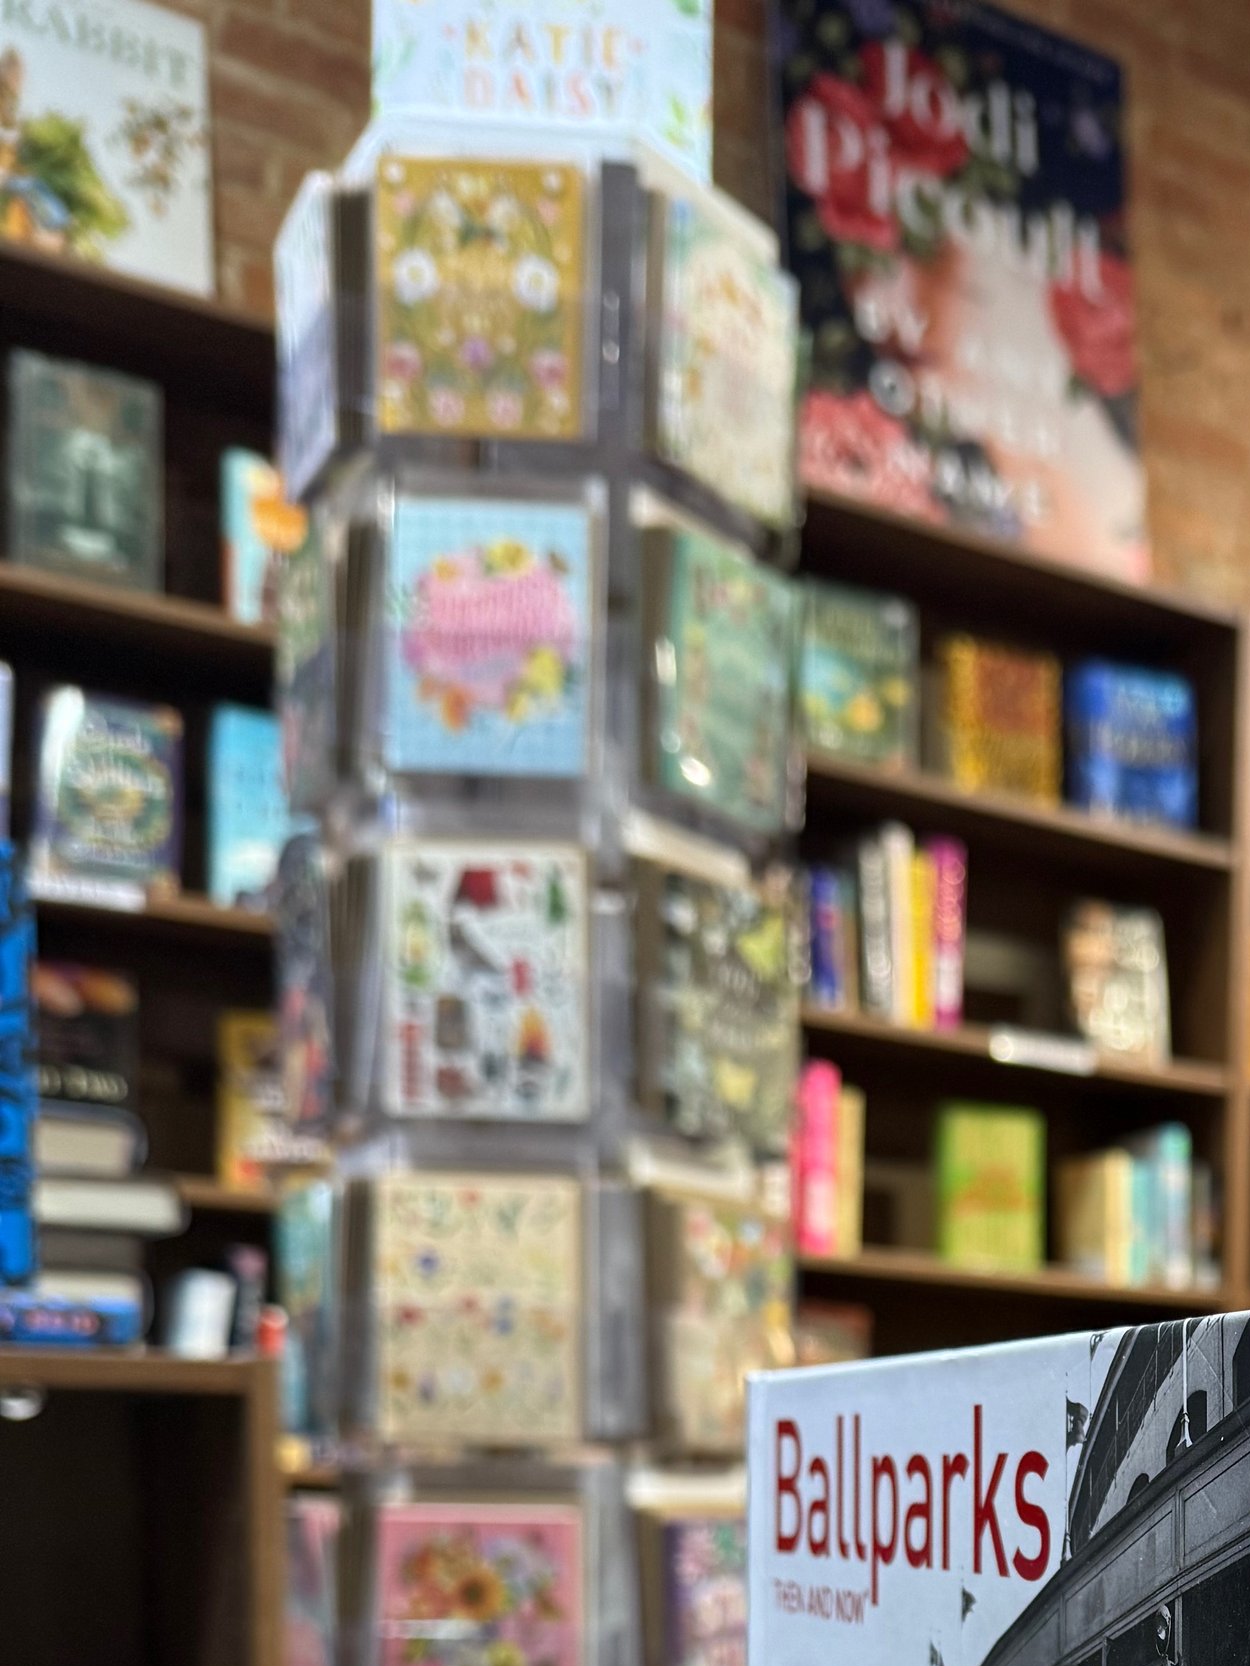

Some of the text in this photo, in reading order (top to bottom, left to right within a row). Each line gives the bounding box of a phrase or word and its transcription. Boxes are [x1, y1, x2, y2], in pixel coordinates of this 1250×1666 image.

[464, 18, 624, 72] KATIE
[464, 69, 623, 117] DAISY
[883, 40, 1038, 176] Jodi
[774, 1404, 1051, 1606] Ballparks
[807, 1584, 833, 1620] AND
